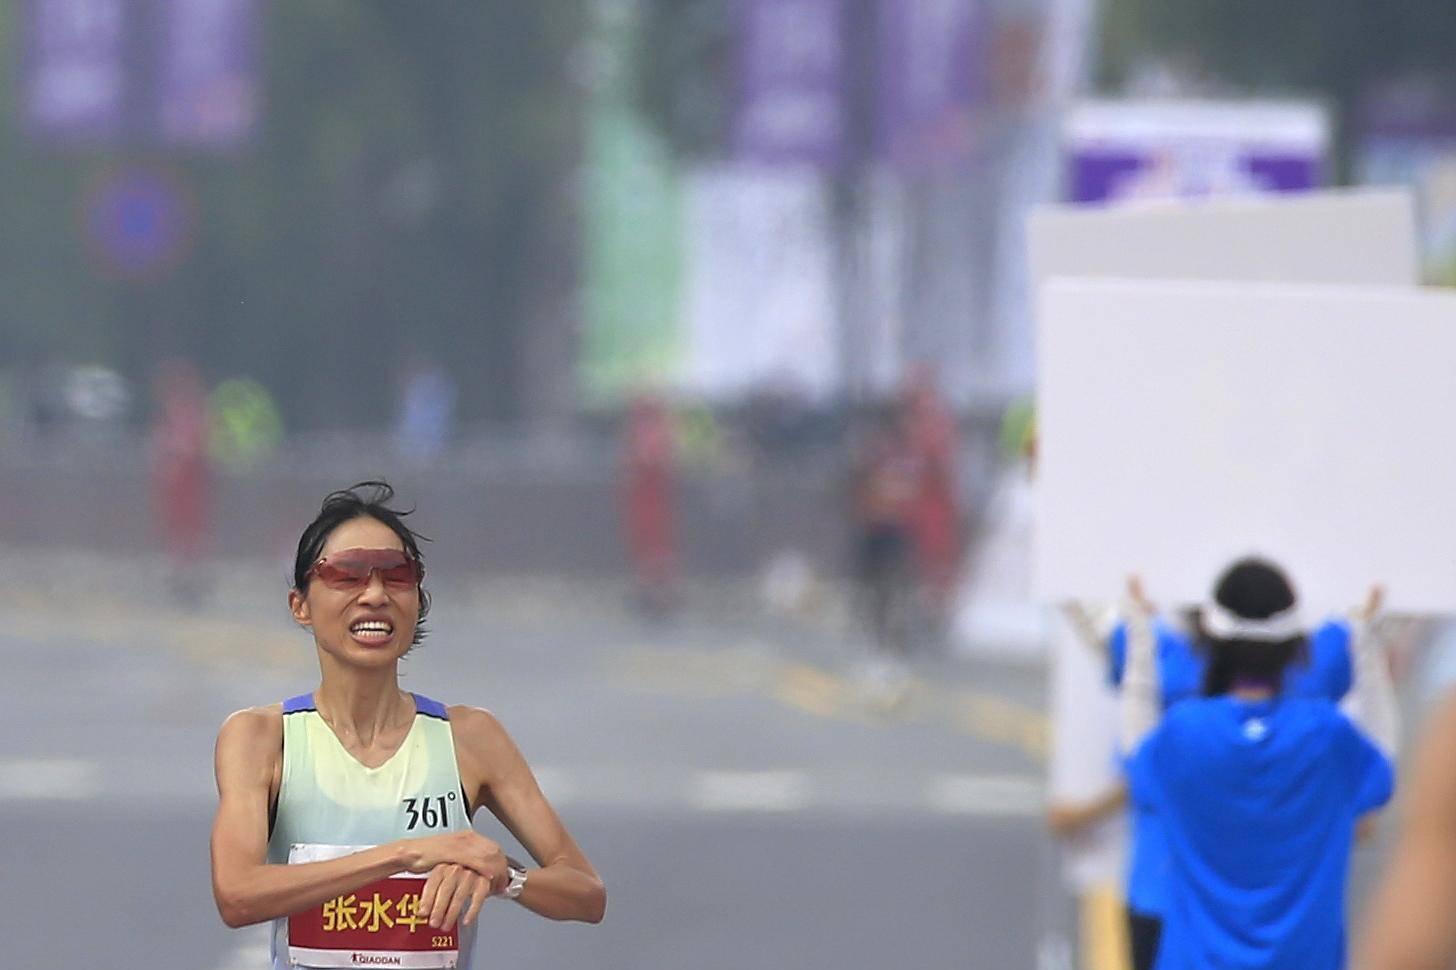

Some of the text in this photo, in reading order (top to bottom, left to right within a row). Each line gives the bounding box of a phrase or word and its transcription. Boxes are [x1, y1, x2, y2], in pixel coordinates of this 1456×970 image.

[403, 791, 456, 830] 361°
[322, 893, 428, 932] 张水华
[359, 956, 401, 965] QIAODAN
